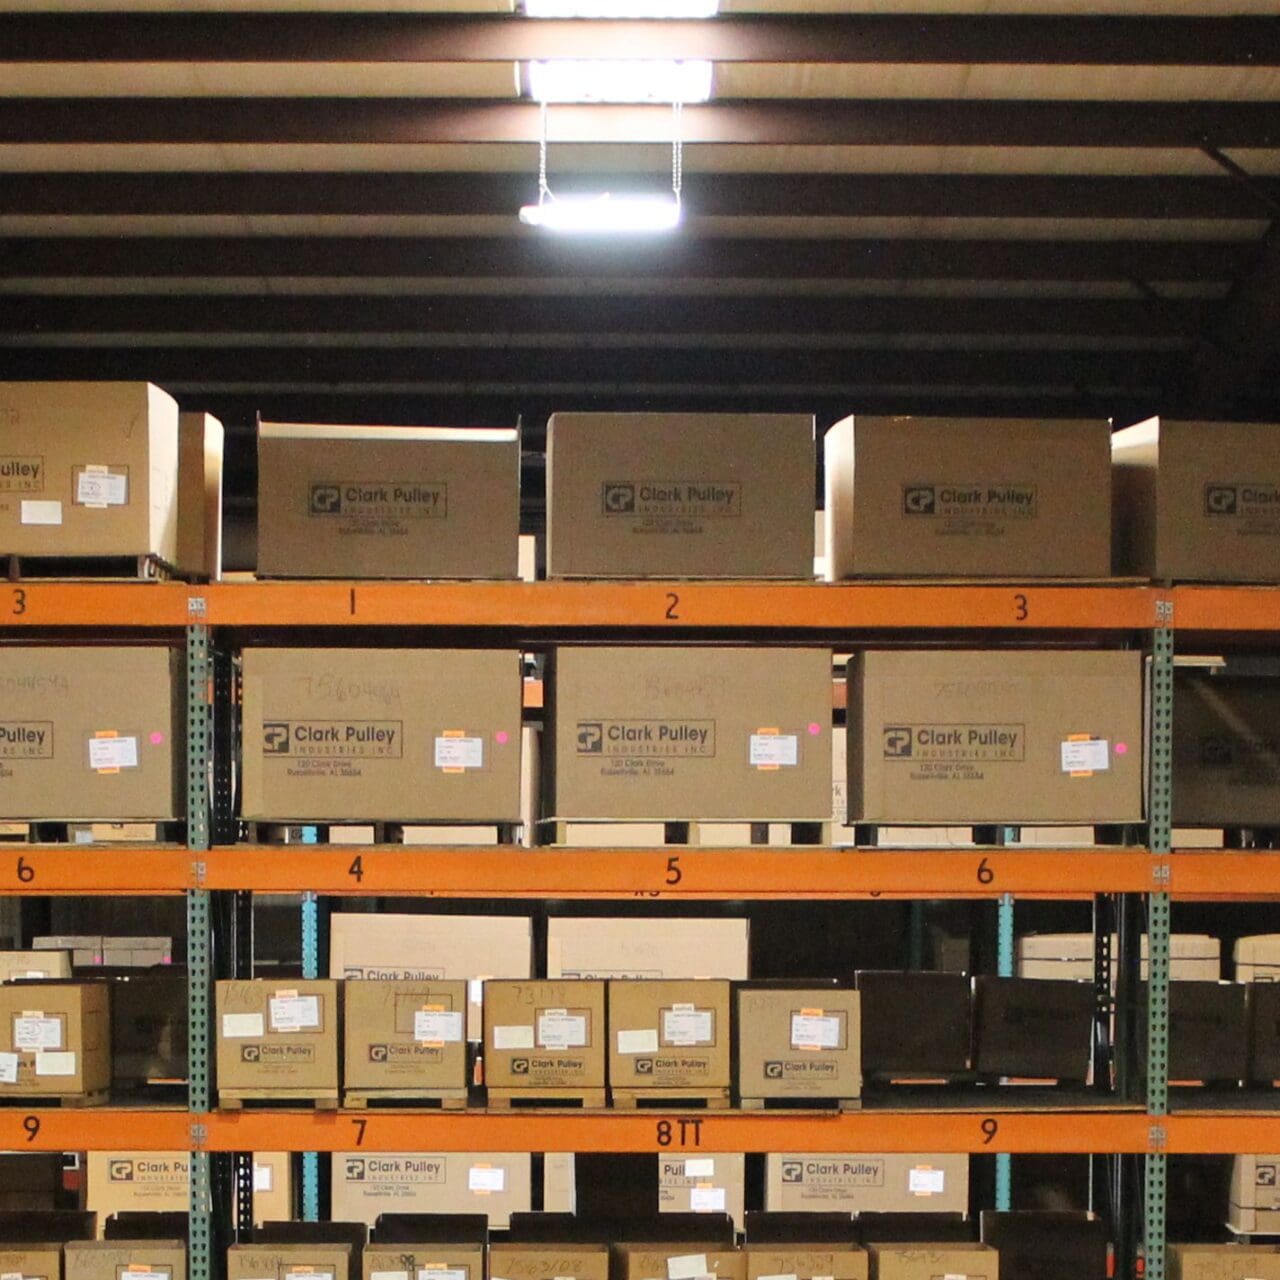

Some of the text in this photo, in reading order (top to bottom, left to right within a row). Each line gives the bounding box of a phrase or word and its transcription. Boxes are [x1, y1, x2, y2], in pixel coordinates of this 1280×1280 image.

[345, 487, 440, 505] Clark Pulley
[639, 486, 735, 504] Clark Pulley
[939, 488, 1035, 507] Clark Pulley
[12, 588, 26, 615] 3
[350, 588, 356, 615] 1
[665, 592, 679, 620] 2
[1014, 594, 1029, 621] 3
[295, 725, 395, 745] Clark Pulley
[608, 724, 708, 744] Clark Pulley
[918, 729, 1017, 748] Clark Pulley
[16, 856, 35, 883] 6
[348, 855, 364, 883] 4
[665, 856, 682, 886] 5
[976, 857, 994, 885] 6
[23, 1115, 41, 1142] 9
[351, 1119, 367, 1146] 7
[980, 1118, 998, 1145] 9
[137, 1162, 169, 1174] Clark
[369, 1160, 440, 1174] Clark Pulley
[807, 1162, 878, 1177] Clark Pulley
